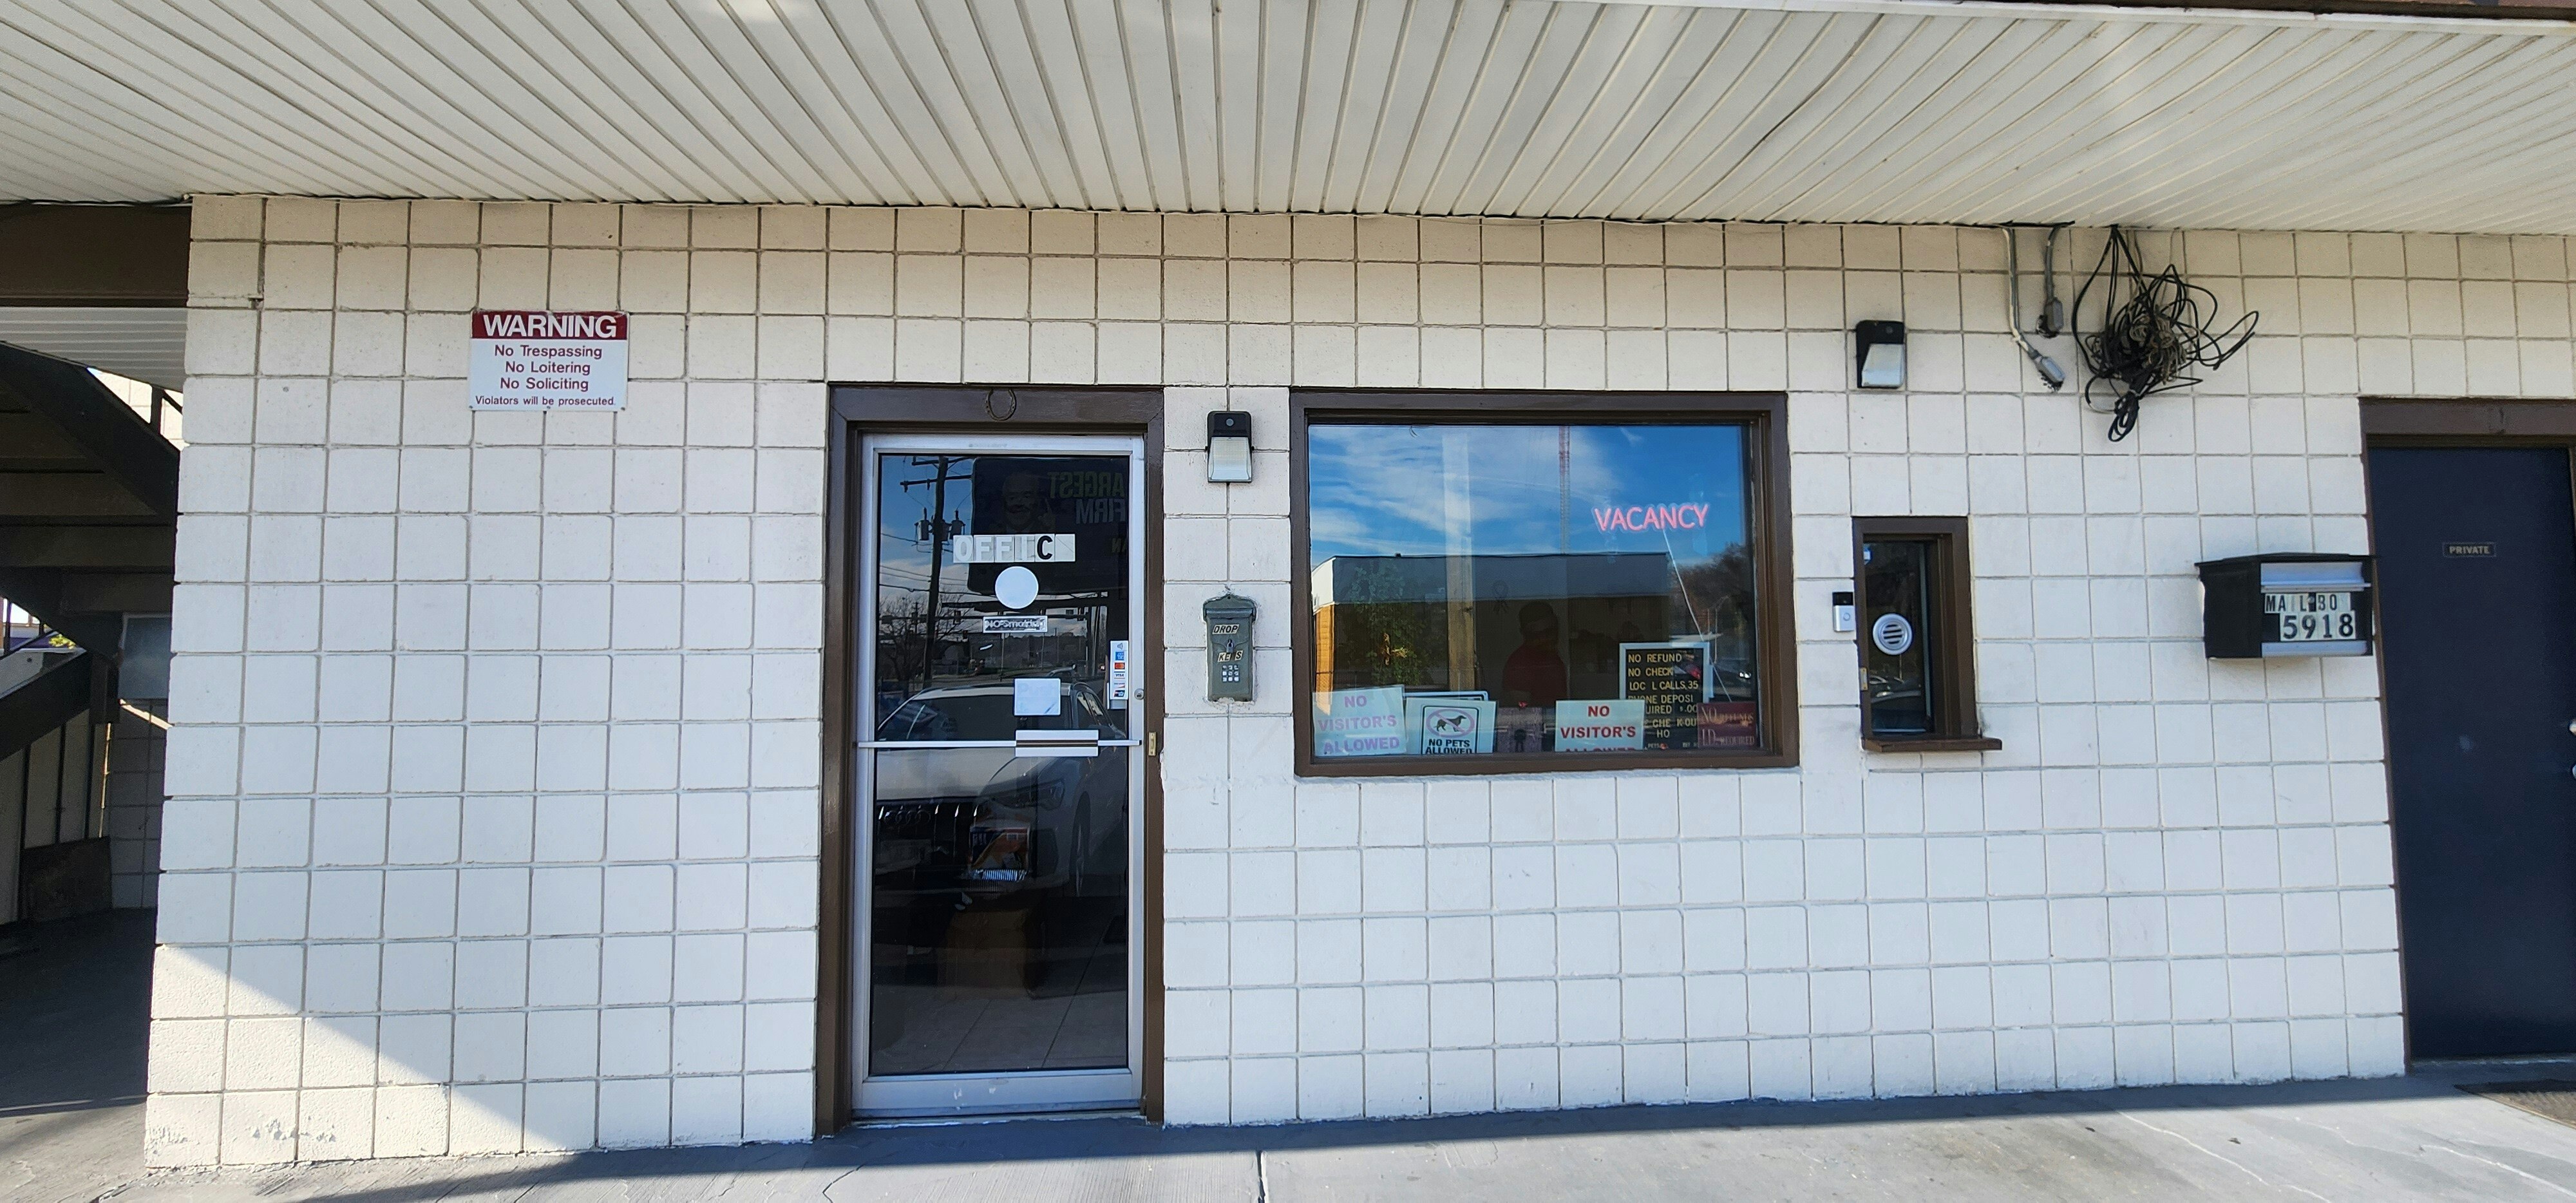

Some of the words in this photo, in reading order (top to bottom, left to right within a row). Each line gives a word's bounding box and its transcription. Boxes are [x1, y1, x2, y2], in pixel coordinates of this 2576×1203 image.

[483, 314, 617, 338] WARNING
[495, 345, 513, 357] No
[520, 345, 602, 359] Trespassing
[505, 361, 524, 373] No
[531, 361, 591, 375] Loitering
[500, 377, 519, 389] No
[526, 377, 589, 392] Soliciting
[475, 395, 518, 405] Violators
[524, 396, 538, 405] will
[542, 396, 554, 406] be
[1595, 504, 1709, 531] VACANCY
[954, 535, 1054, 562] OFFIC
[2449, 545, 2490, 554] PRIVATE
[2318, 594, 2338, 611] BO
[1213, 625, 1238, 634] DROP
[2283, 613, 2354, 639] 5918
[1628, 654, 1642, 663] NO
[1647, 653, 1682, 663] REFUND
[1628, 668, 1641, 676] NO
[1645, 667, 1674, 676] CHECK
[1344, 695, 1367, 708] NO
[1587, 706, 1610, 717] NO
[1318, 715, 1397, 731] VISITOR'S
[1560, 726, 1636, 739] VISITOR'S
[1323, 737, 1400, 753] ALLOWED
